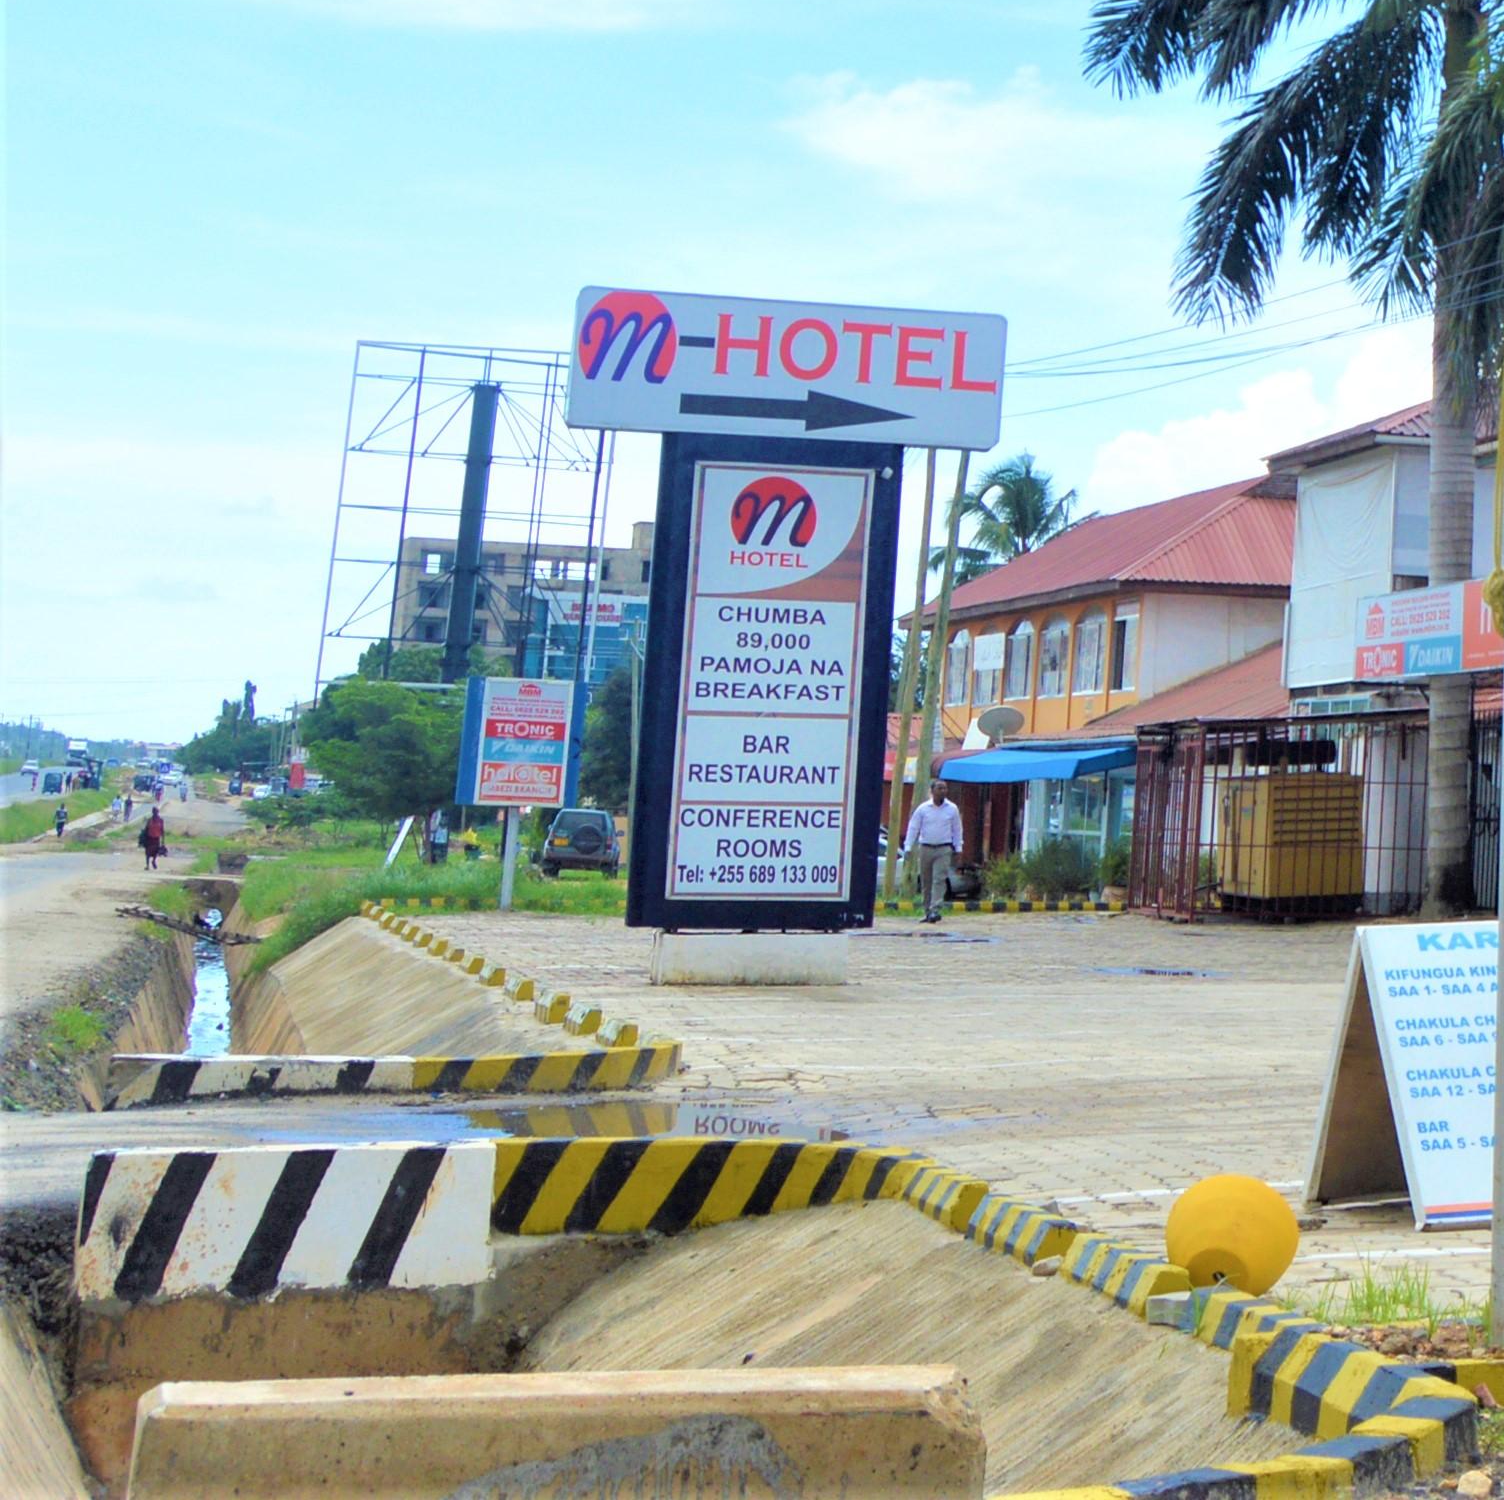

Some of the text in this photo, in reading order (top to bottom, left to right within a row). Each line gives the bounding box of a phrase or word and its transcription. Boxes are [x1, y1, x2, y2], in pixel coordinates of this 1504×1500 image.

[729, 550, 808, 568] HOTEL
[718, 606, 826, 625] CHUMBA
[736, 632, 811, 651] 89,000
[1362, 646, 1397, 674] TRONIC
[1418, 645, 1454, 668] DAIKIN
[700, 657, 844, 676] PAMOJA NA
[695, 682, 846, 701] BREAKFAST
[495, 722, 555, 737] TRONIC
[743, 735, 790, 754] BAR
[688, 764, 841, 785] RESTAURANT
[681, 808, 841, 829] CONFERENCE
[716, 839, 802, 858] ROOMS
[678, 865, 837, 884] Tel: +255 689 133 009
[1385, 967, 1465, 980] KIFUNGUA
[1388, 985, 1419, 997] SAA
[1442, 983, 1472, 995] SAA
[1477, 982, 1485, 993] 4
[1395, 1016, 1470, 1030] CHAKULA
[1398, 1035, 1430, 1048] SAA
[1435, 1034, 1444, 1046] 6
[1457, 1032, 1488, 1044] SAA
[1406, 1066, 1481, 1081] CHAKULA
[1410, 1086, 1441, 1099] SAA
[1446, 1085, 1464, 1097] 12
[1417, 1121, 1449, 1134] BAR
[1421, 1138, 1452, 1152] SAA
[1457, 1137, 1466, 1149] 5
